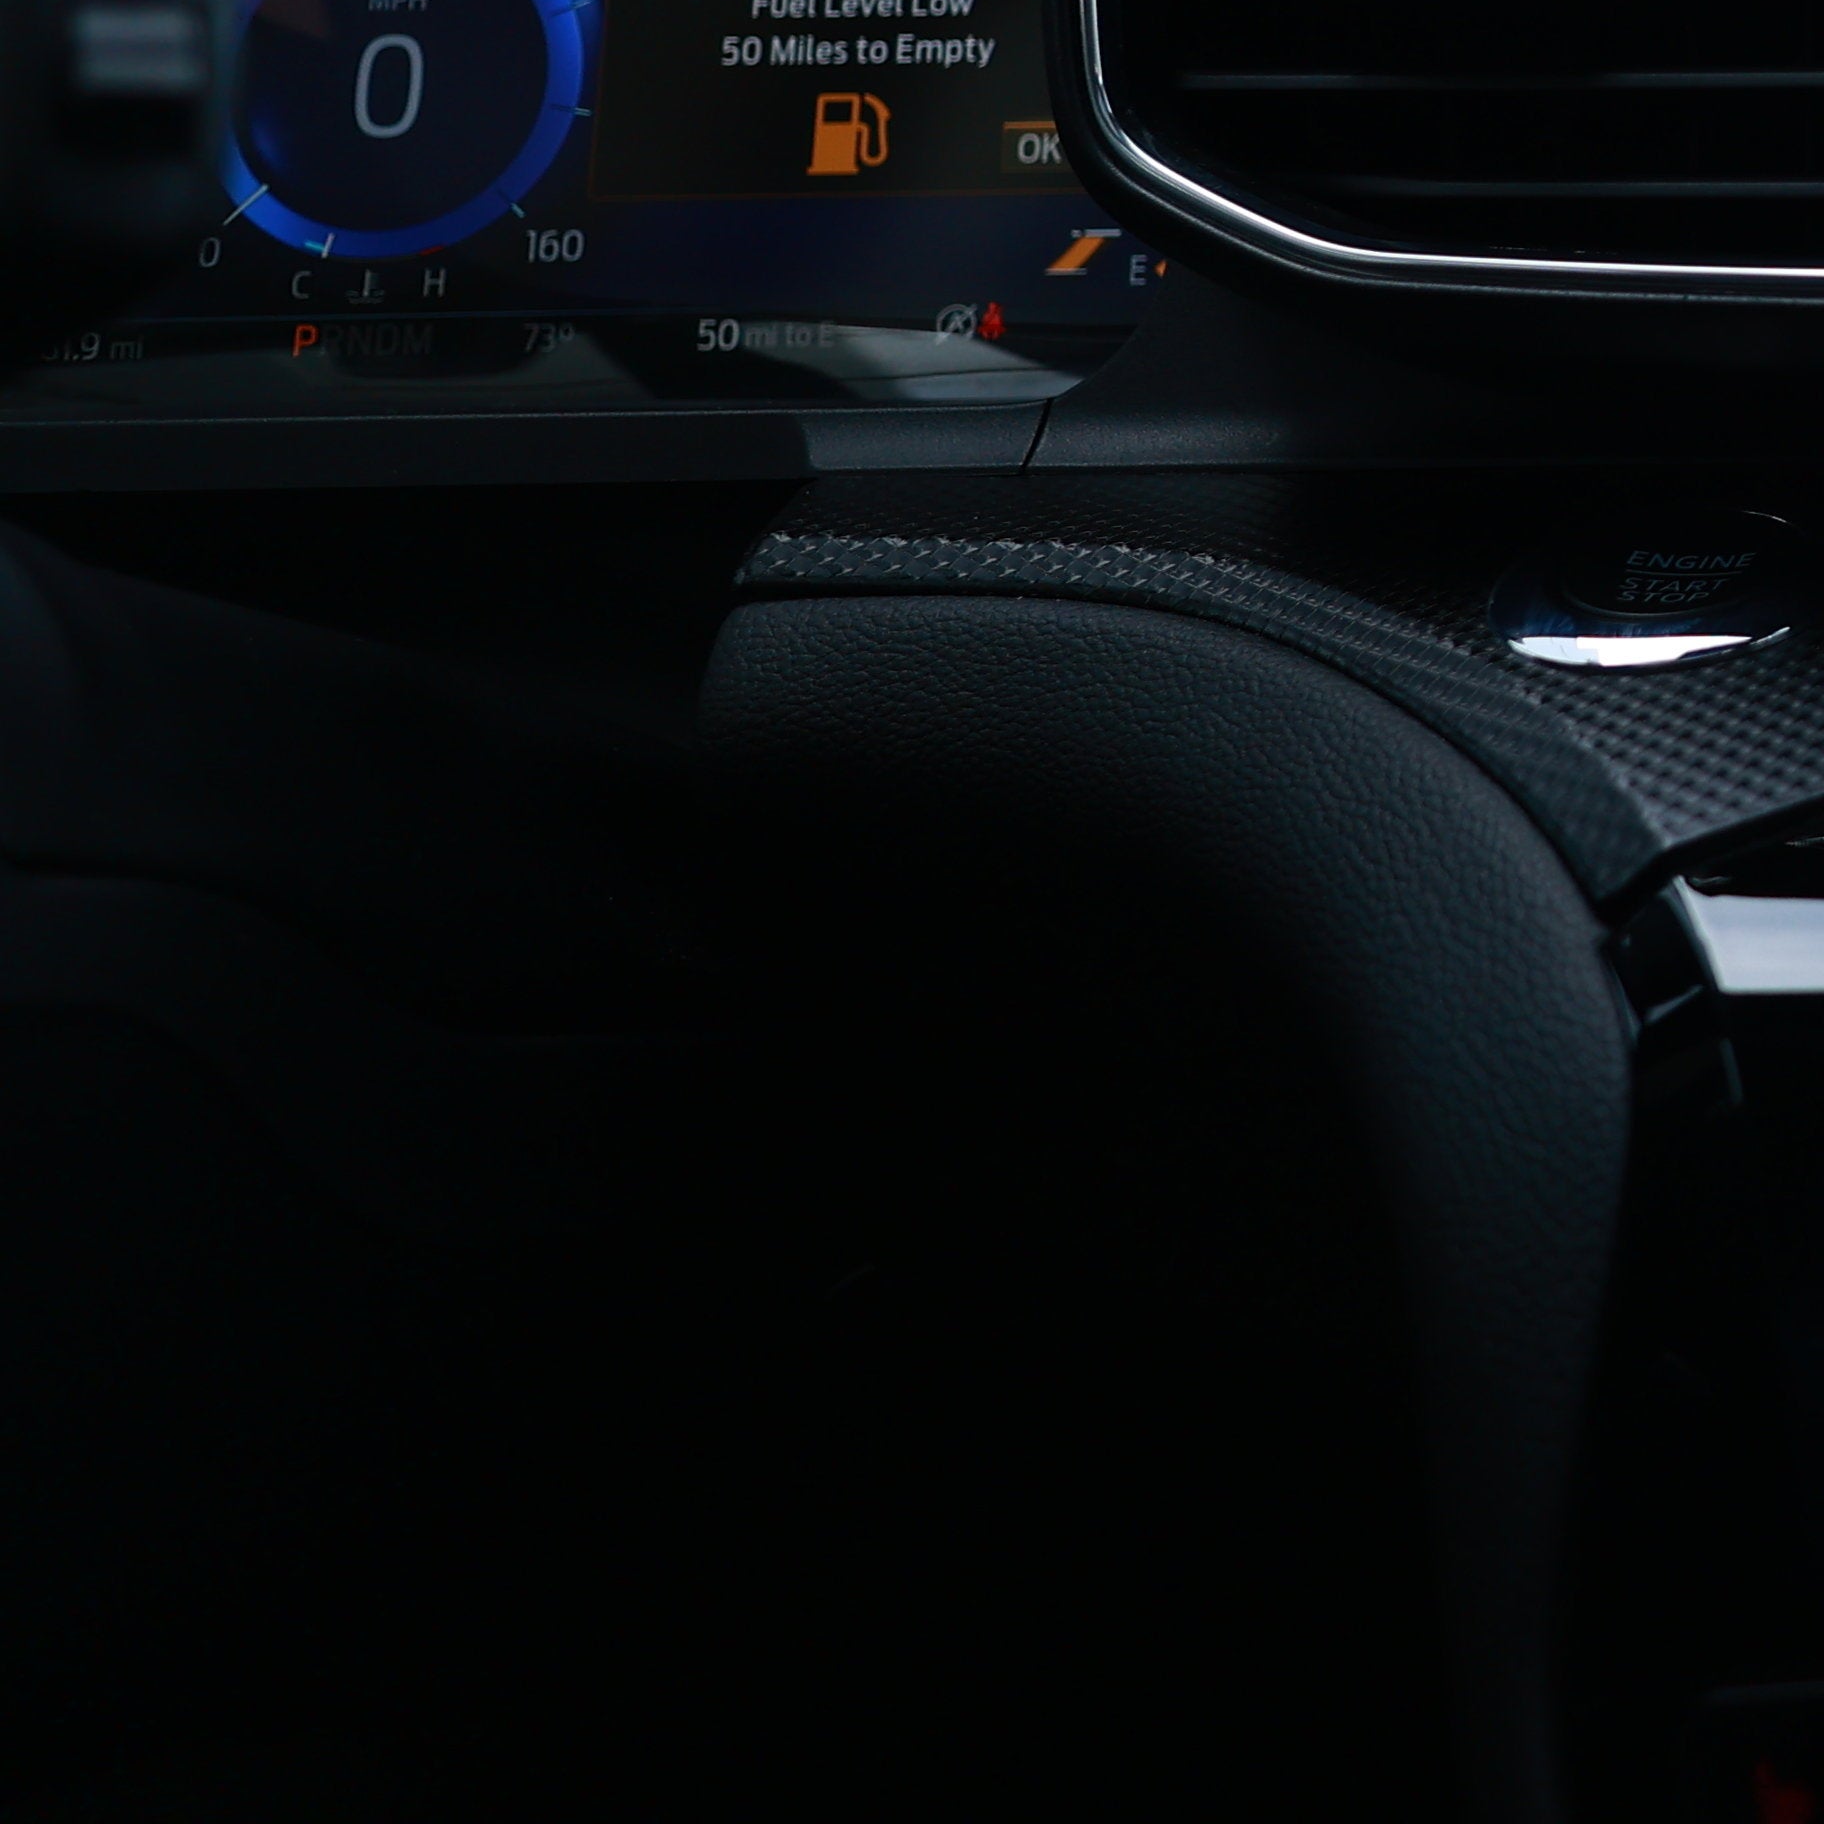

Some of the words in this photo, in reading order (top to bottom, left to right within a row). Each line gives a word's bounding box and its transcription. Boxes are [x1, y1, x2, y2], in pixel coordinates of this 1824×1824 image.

[722, 36, 762, 66] 50
[771, 35, 847, 65] Miles
[857, 36, 888, 64] to
[896, 34, 994, 68] Empty
[353, 33, 424, 138] 0
[1017, 132, 1061, 164] OK
[528, 228, 585, 263] 160
[695, 317, 741, 353] 50
[1625, 550, 1758, 570] ENGINE
[1616, 590, 1711, 604] STOP
[1618, 576, 1732, 592] START
